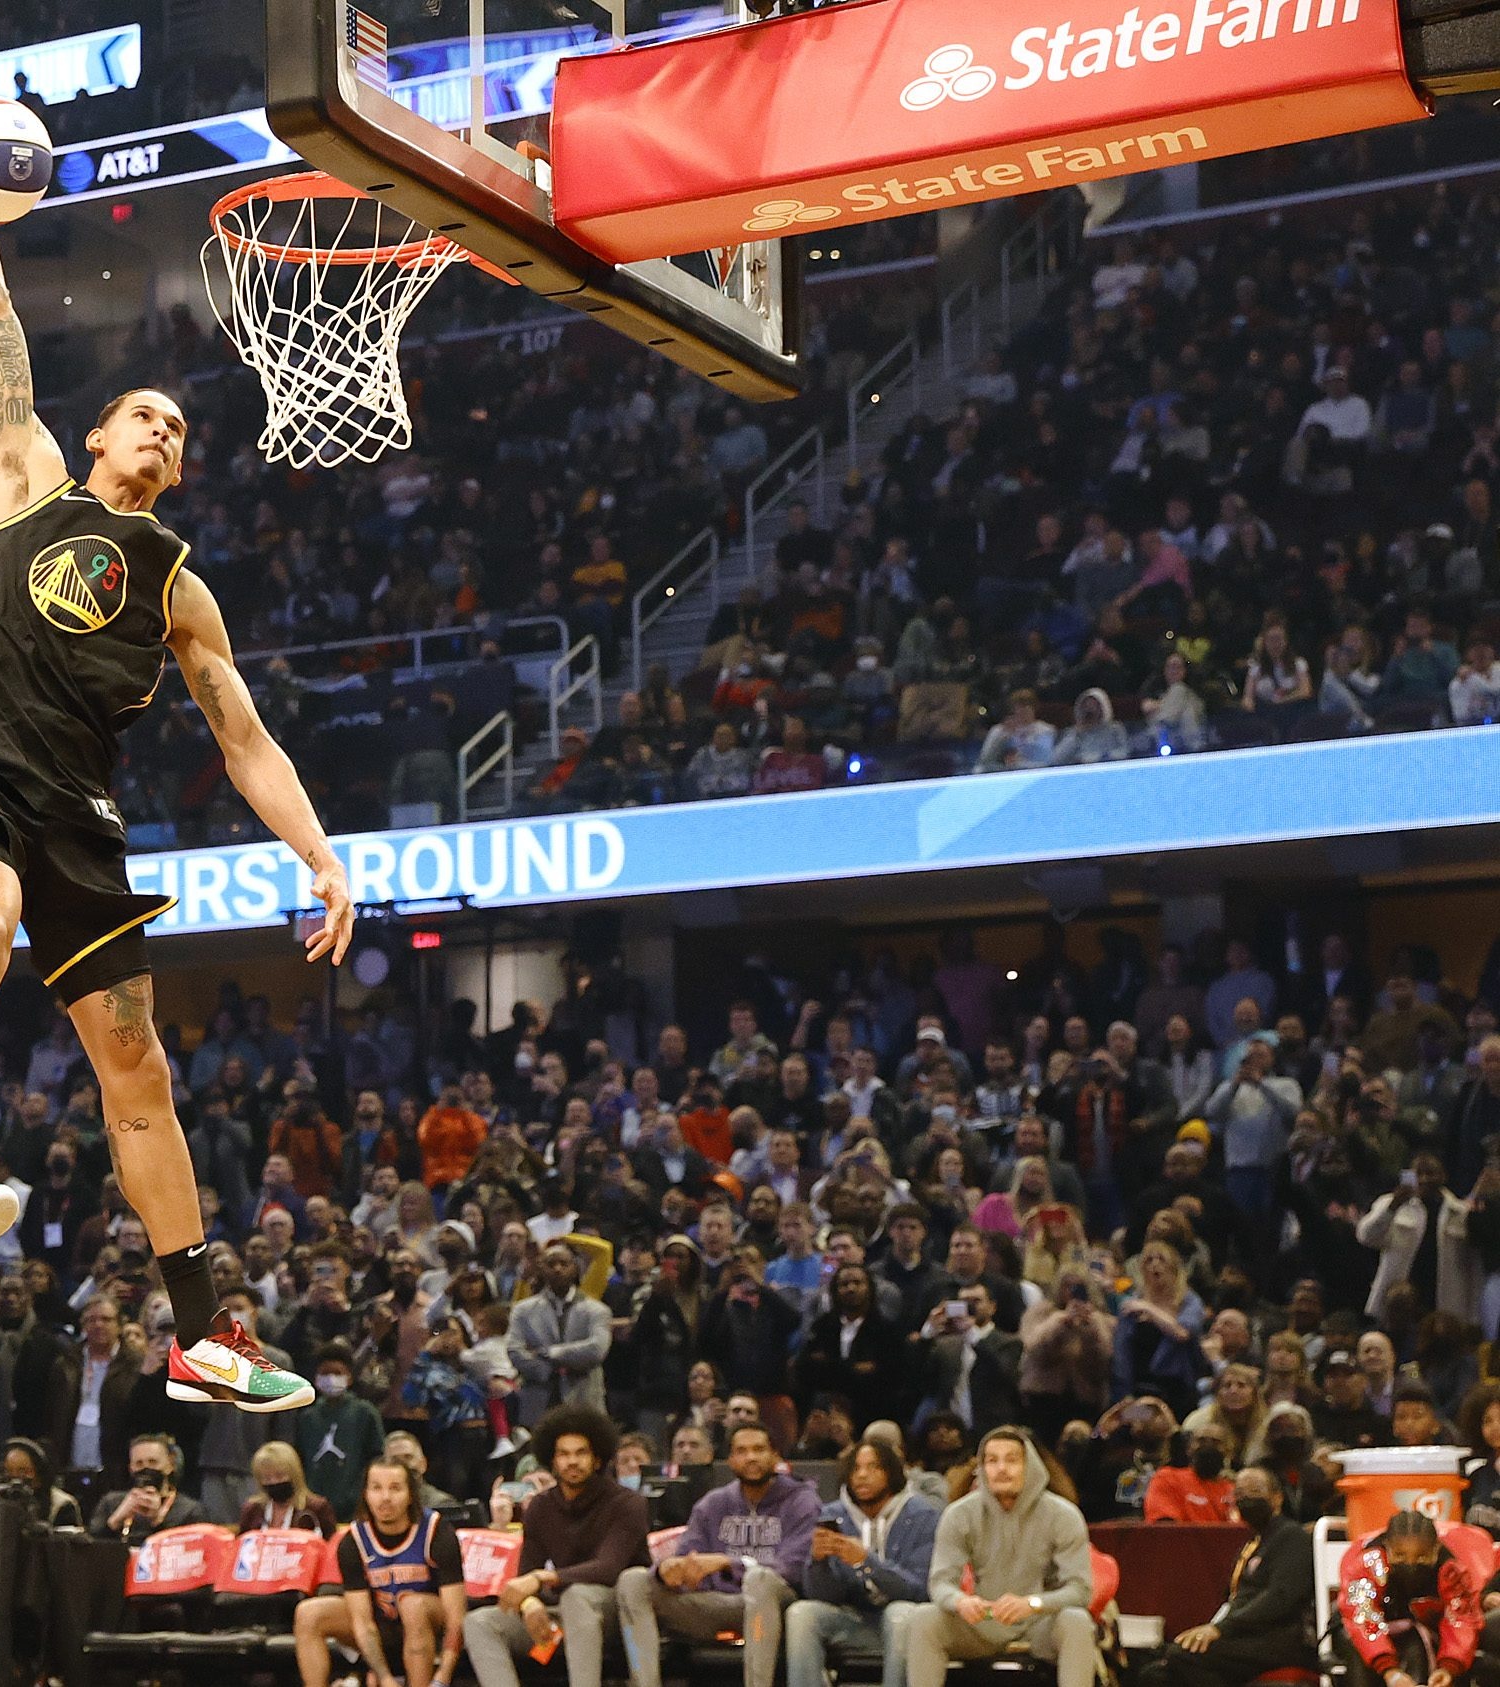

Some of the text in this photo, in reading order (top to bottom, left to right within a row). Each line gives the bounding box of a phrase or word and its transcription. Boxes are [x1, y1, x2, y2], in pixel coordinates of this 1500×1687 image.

[97, 142, 165, 184] AT&T
[86, 554, 124, 591] 95
[125, 818, 625, 928] FIRST ROUND
